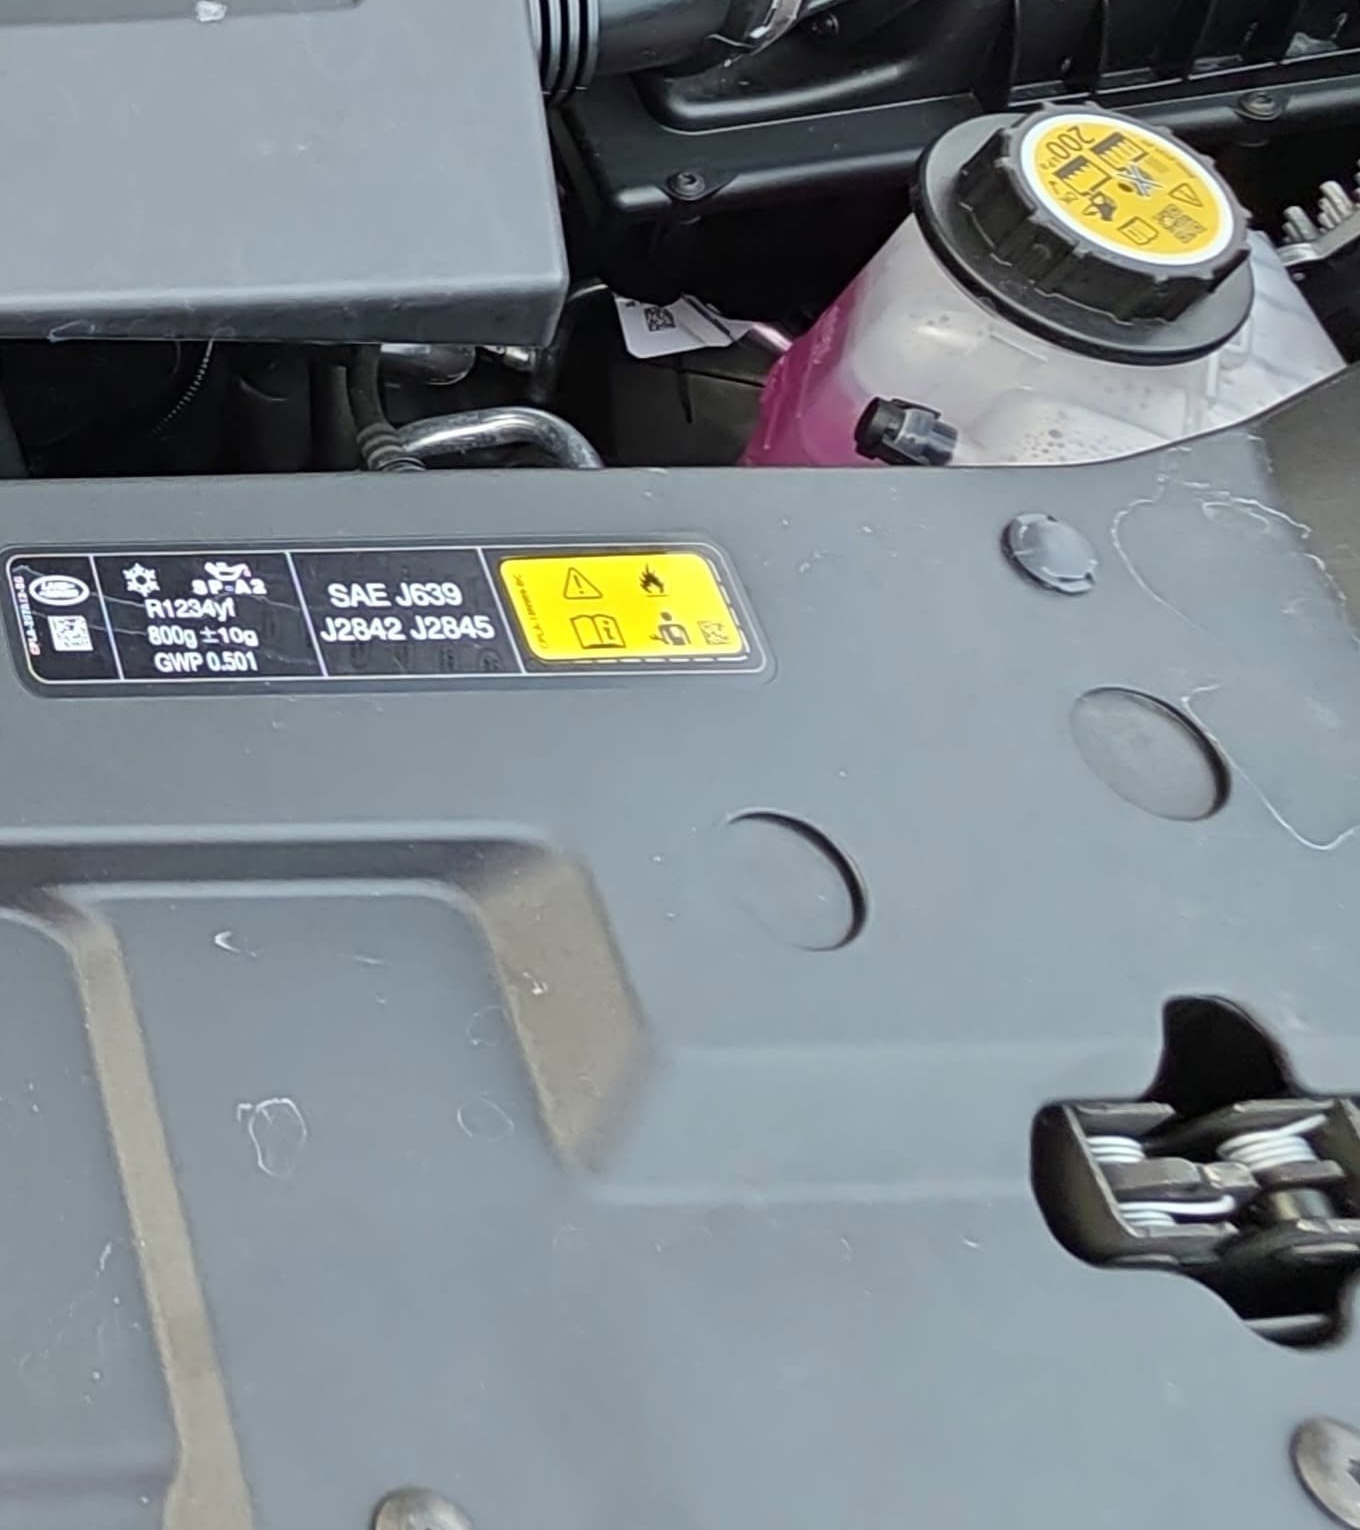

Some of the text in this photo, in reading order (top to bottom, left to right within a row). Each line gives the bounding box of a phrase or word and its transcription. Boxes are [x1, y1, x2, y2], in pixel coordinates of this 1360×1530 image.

[327, 582, 463, 608] SAE J639
[144, 598, 236, 622] R1234yf
[147, 625, 198, 649] 800g
[320, 615, 495, 642] J2842 J2845
[154, 651, 258, 672] GWP 0.501
